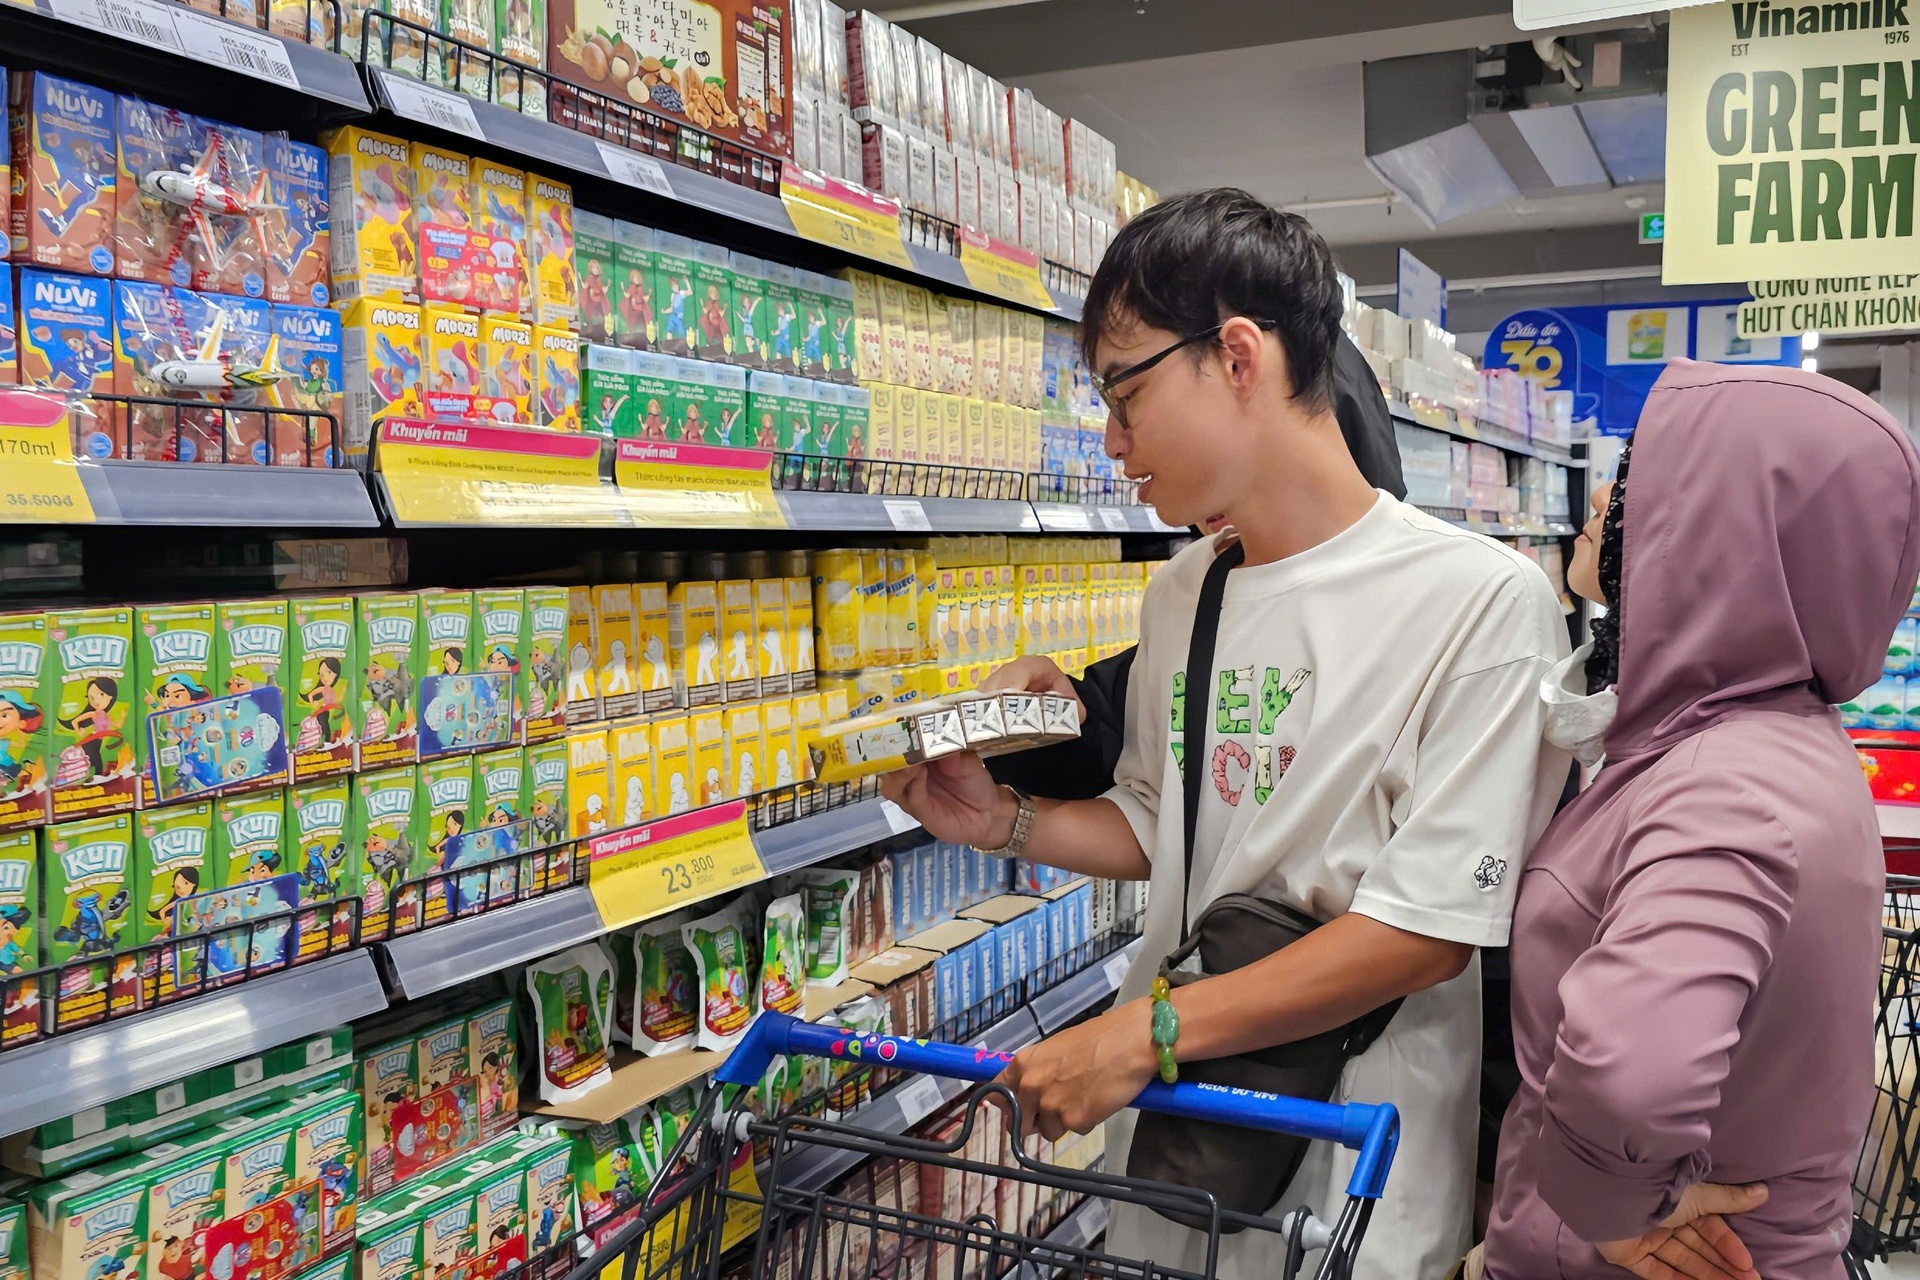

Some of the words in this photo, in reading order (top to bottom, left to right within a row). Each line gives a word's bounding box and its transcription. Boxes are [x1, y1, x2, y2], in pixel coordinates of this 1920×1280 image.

[1884, 30, 1910, 45] 1976
[1732, 43, 1749, 57] EST
[1706, 60, 1920, 157] GREEN
[1717, 153, 1917, 246] FARM
[34, 282, 97, 308] NuVi
[1792, 298, 1848, 330] CHÂN
[1855, 292, 1920, 327] KHÔN
[390, 424, 441, 443] Khuyến
[443, 429, 467, 443] mãi
[622, 442, 659, 460] Khuyến
[596, 833, 632, 855] Khuyến
[662, 863, 692, 894] 23
